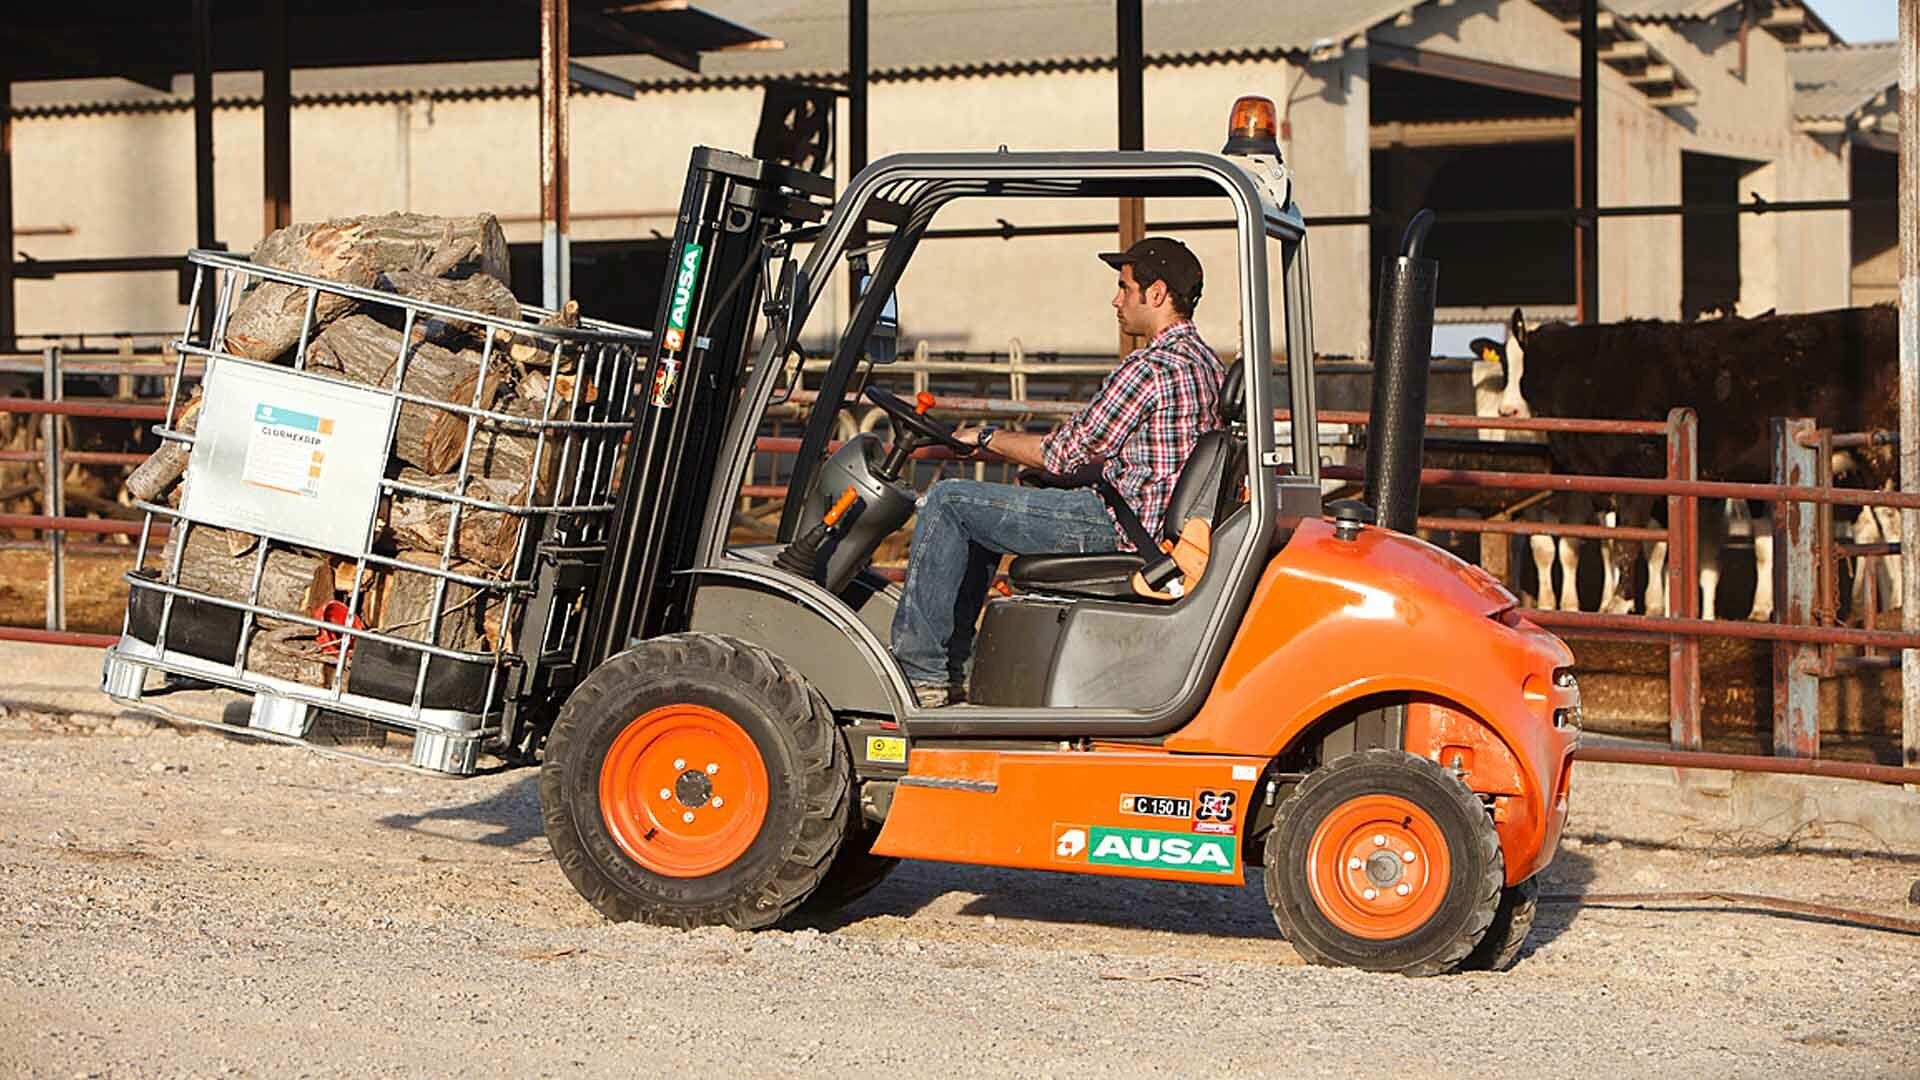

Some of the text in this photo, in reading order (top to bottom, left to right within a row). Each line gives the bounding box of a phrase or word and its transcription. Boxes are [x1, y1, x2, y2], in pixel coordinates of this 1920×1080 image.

[672, 249, 699, 327] AUSA
[1137, 798, 1188, 816] C 150 H
[1092, 834, 1230, 867] AUSA
